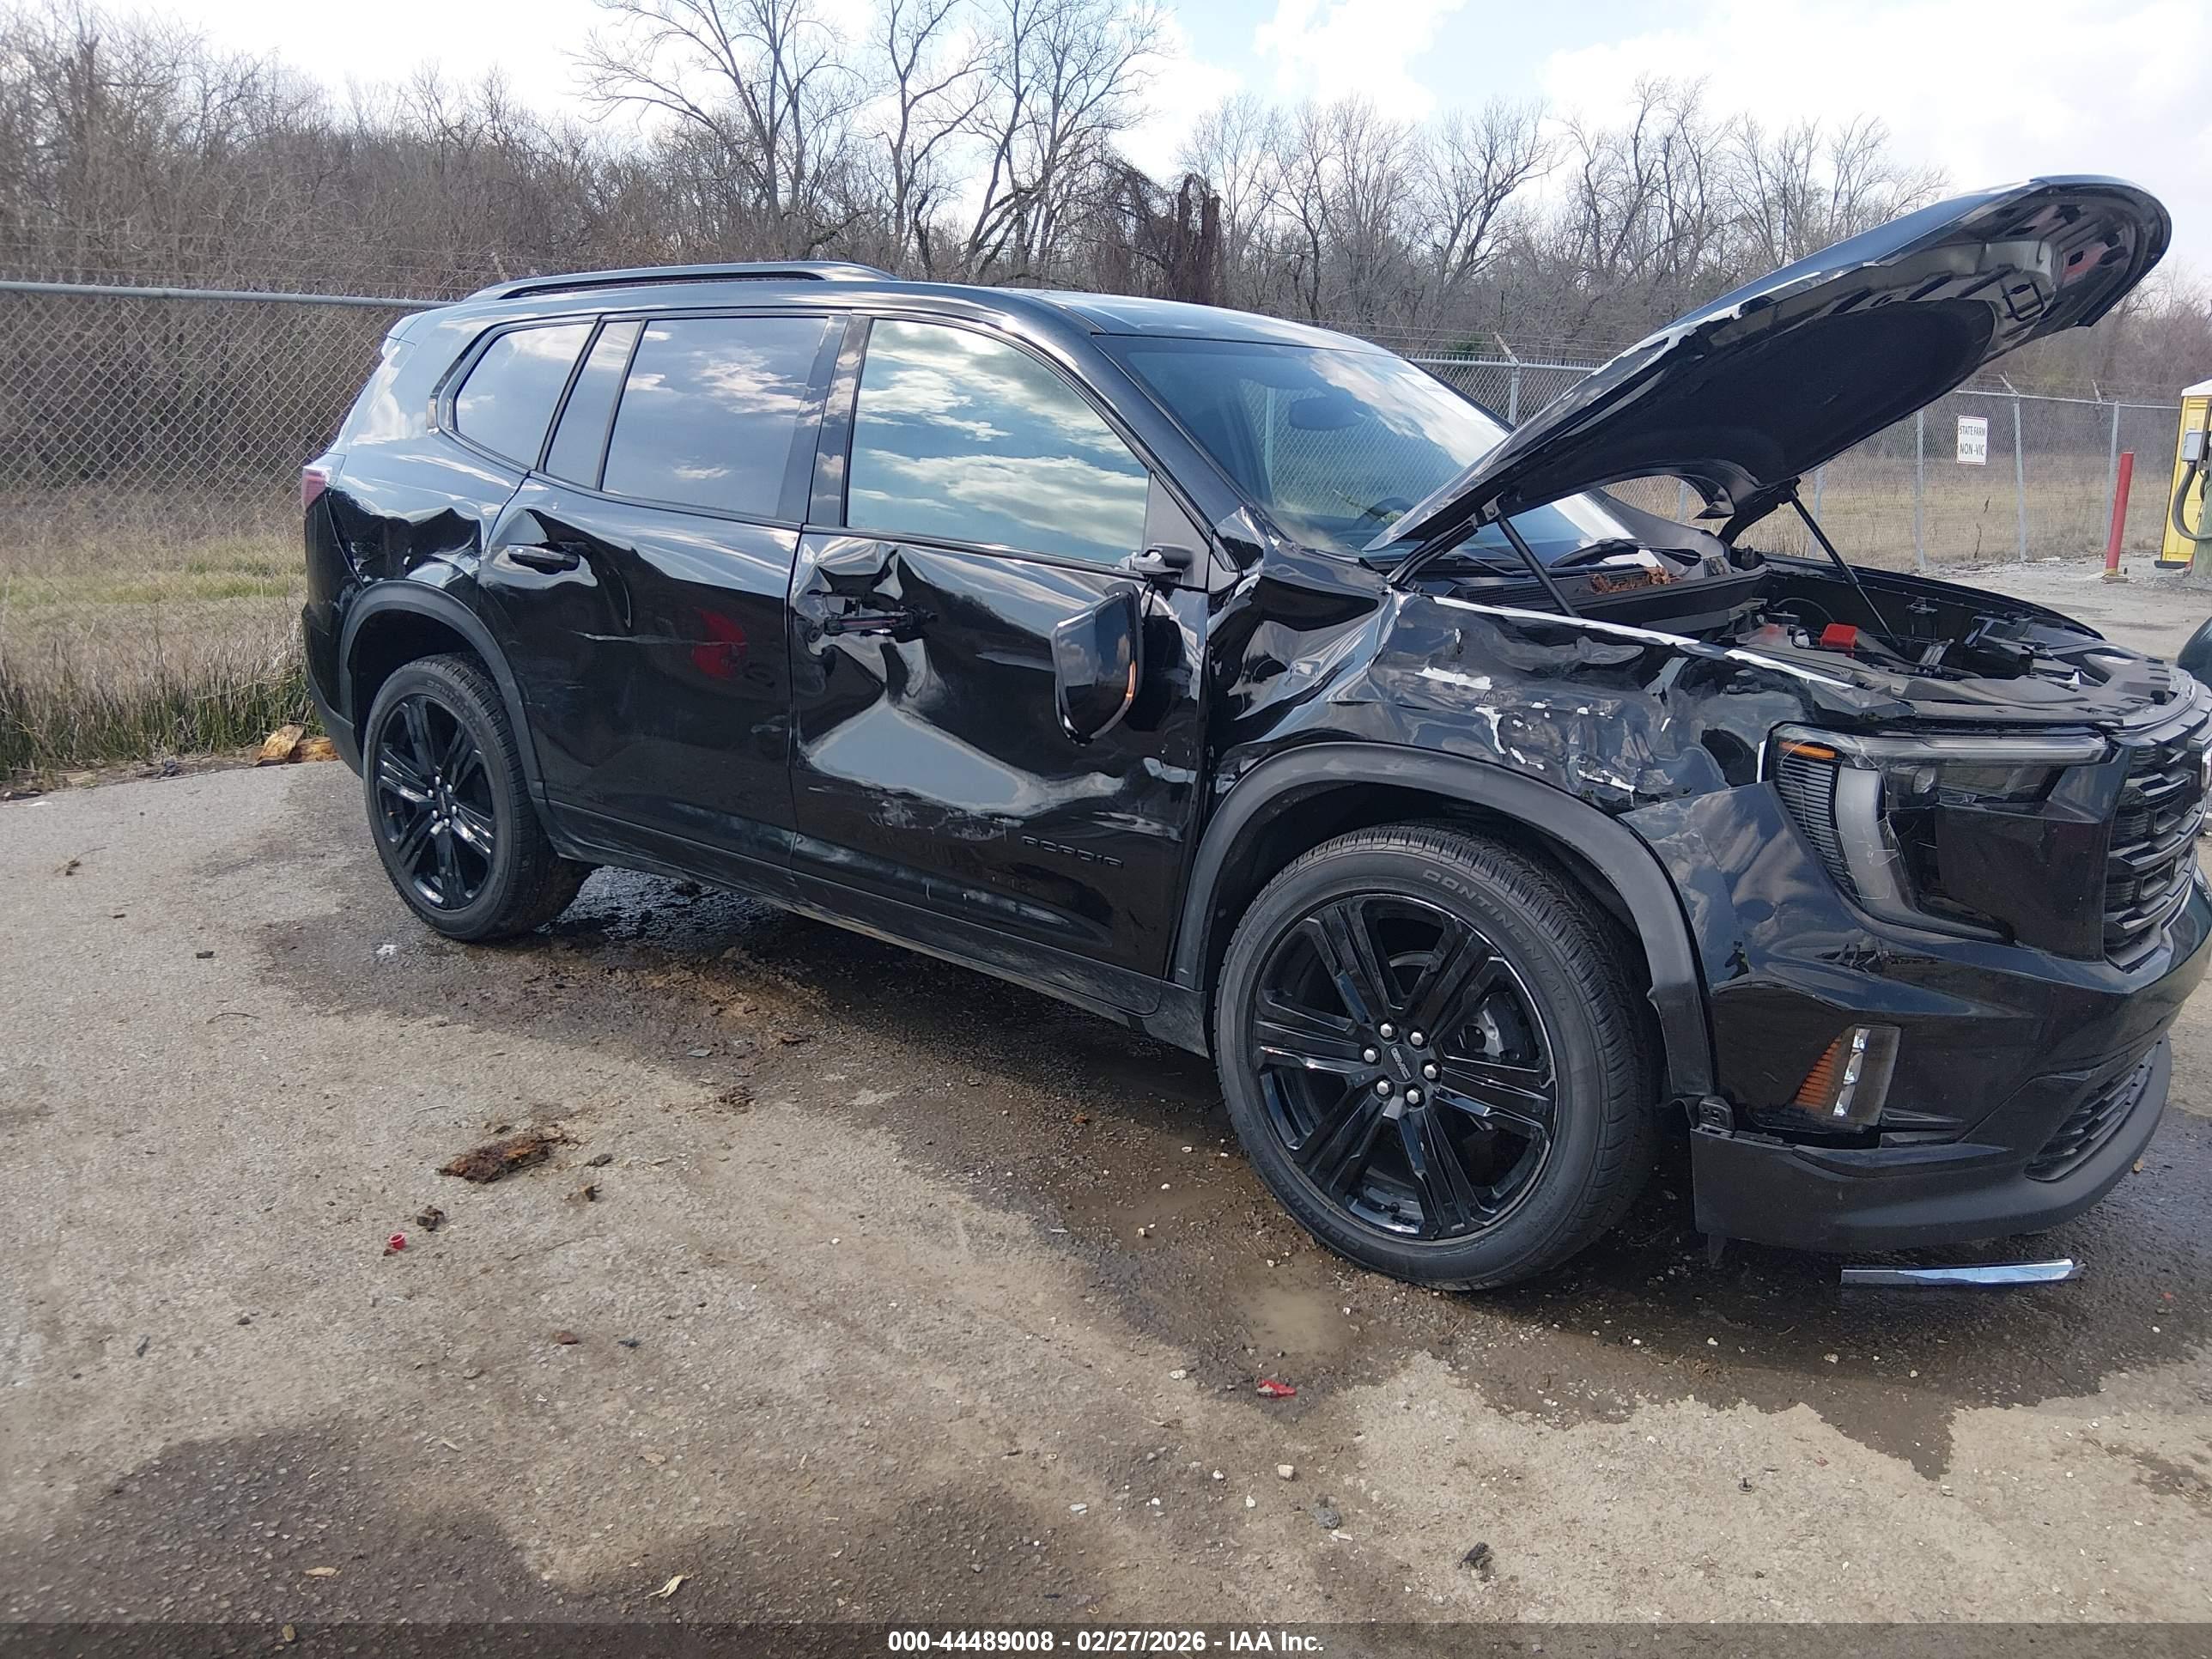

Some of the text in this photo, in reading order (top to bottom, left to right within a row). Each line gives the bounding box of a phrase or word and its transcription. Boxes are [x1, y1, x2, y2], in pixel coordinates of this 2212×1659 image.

[1960, 426, 1985, 436] STATE FARM
[1960, 443, 1984, 456] NON-VIC
[1021, 836, 1124, 869] ACADIA
[1390, 1047, 1412, 1080] GMC
